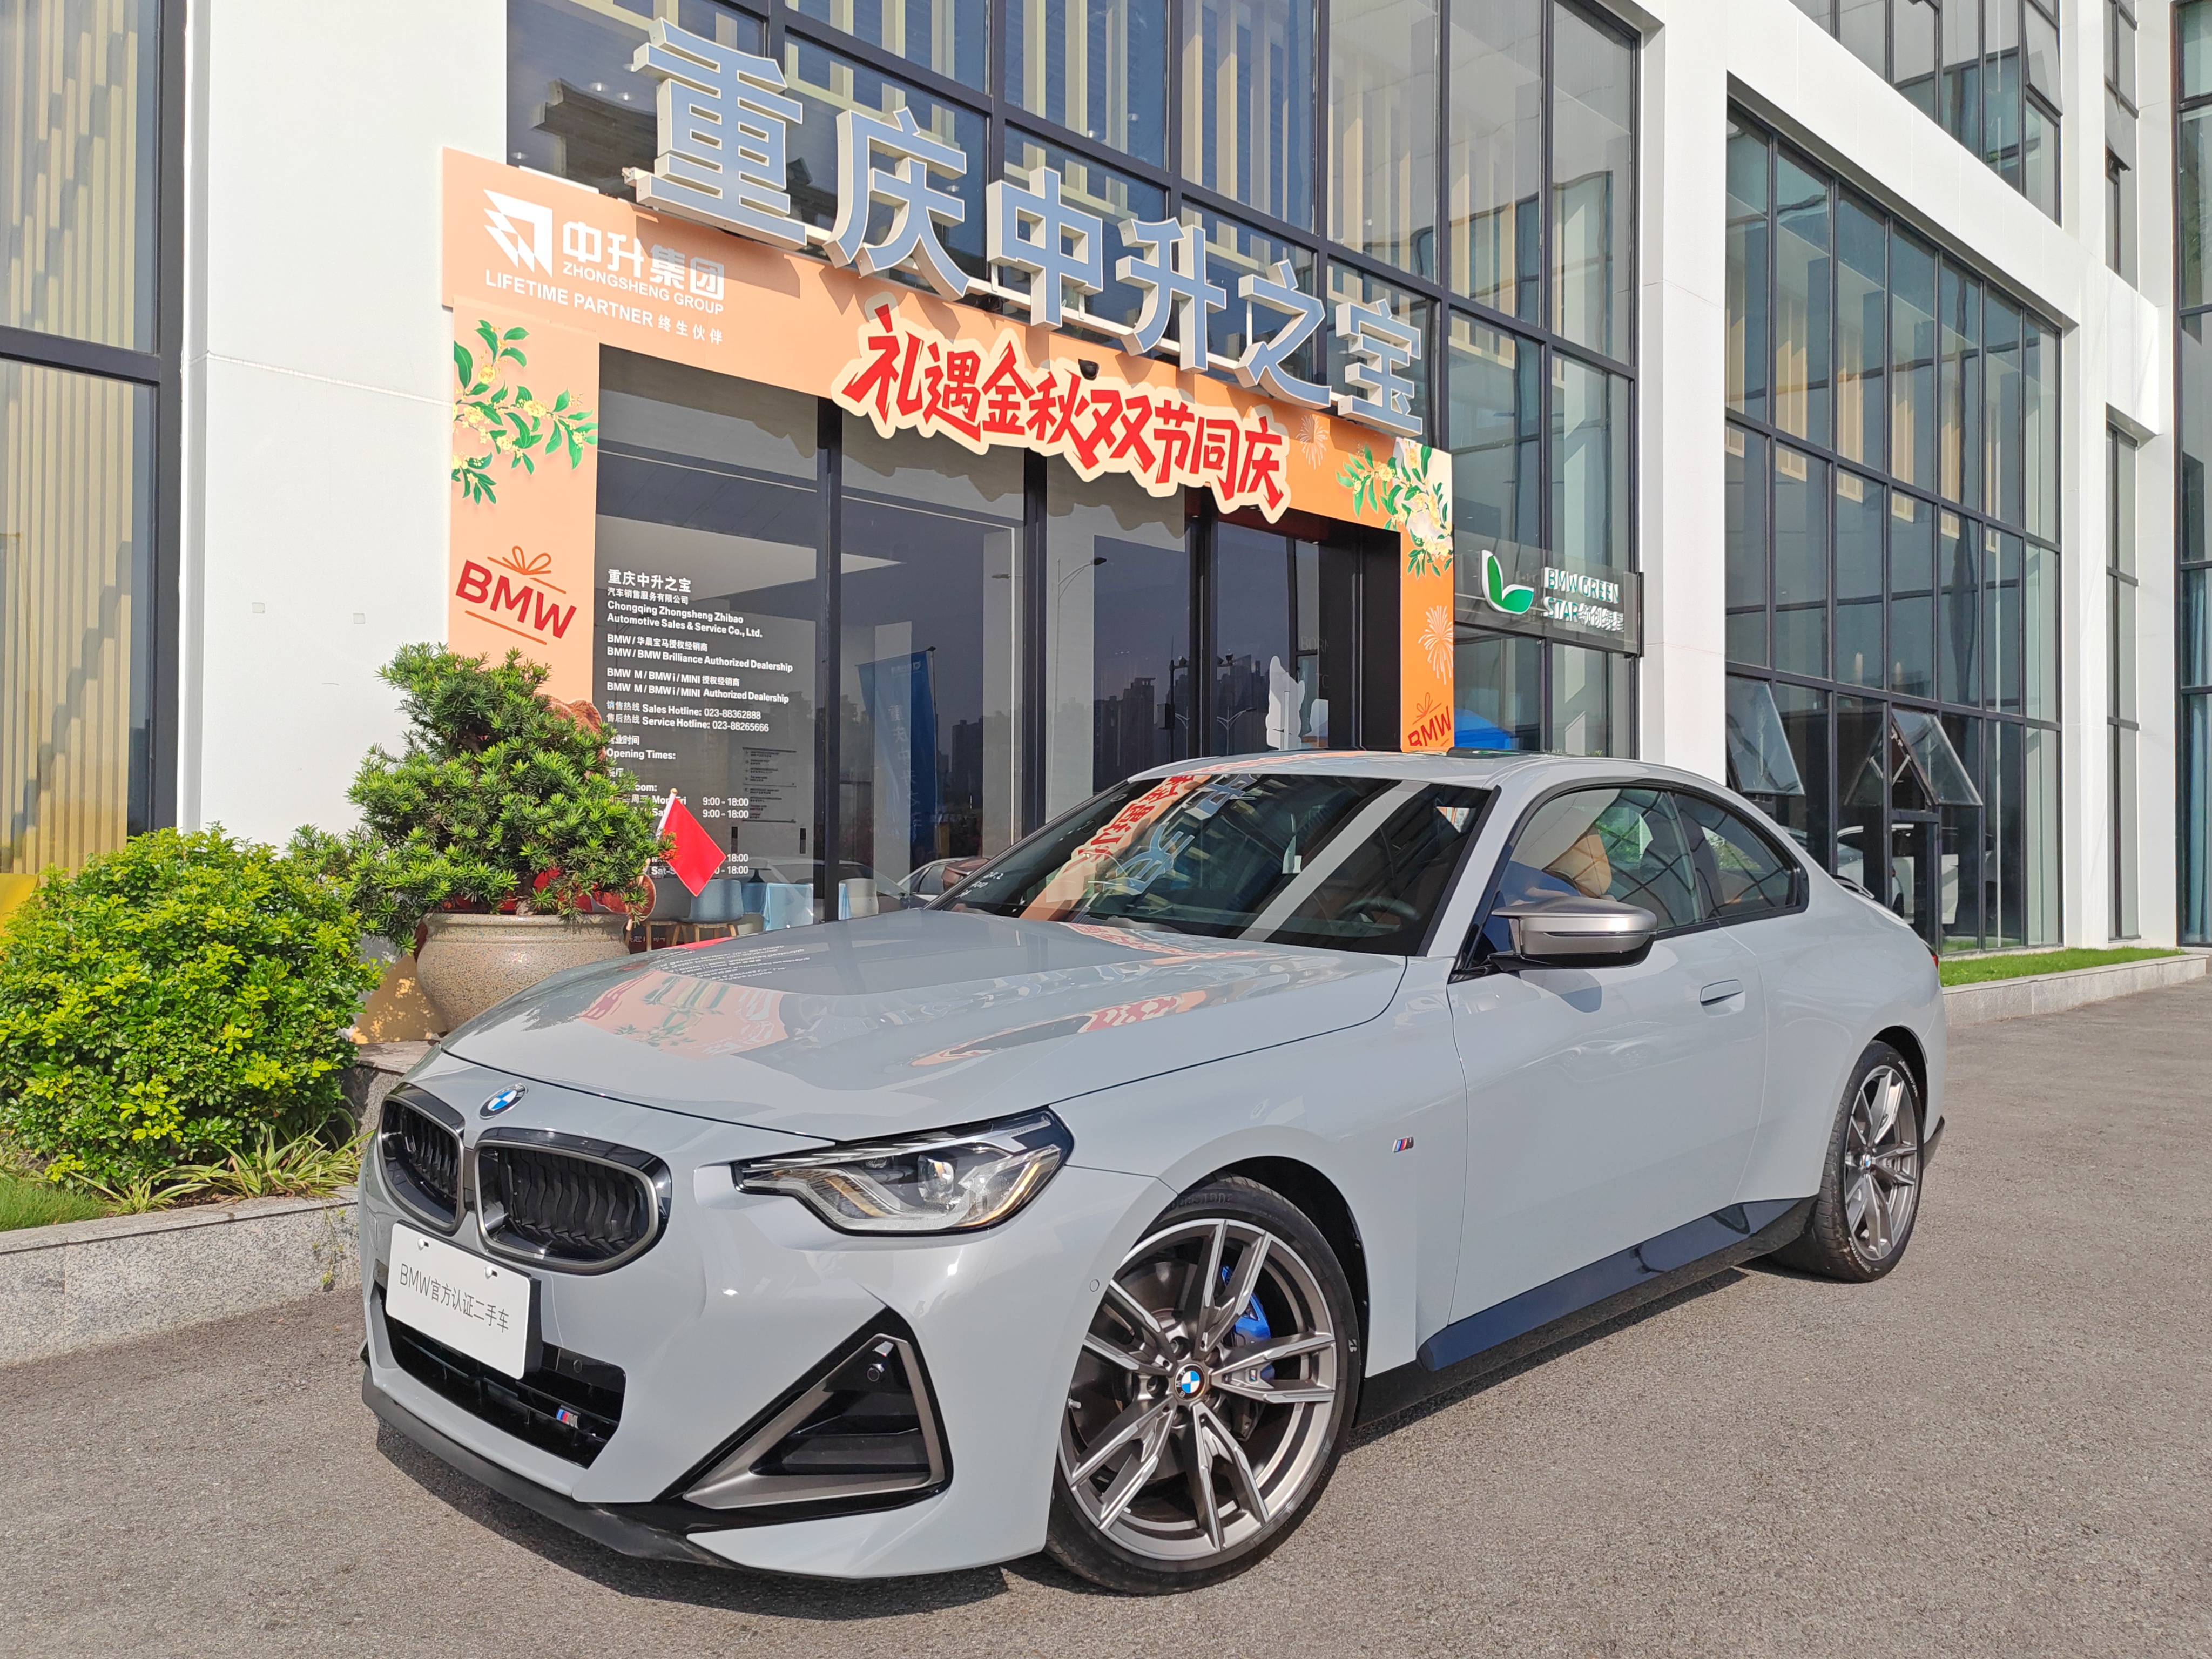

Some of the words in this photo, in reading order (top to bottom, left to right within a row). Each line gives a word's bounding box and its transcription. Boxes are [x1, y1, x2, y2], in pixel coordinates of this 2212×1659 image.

[634, 21, 1422, 435] 重庆中升之宝
[563, 221, 724, 300] 中升集团
[563, 261, 670, 302] ZHONGSHENG
[674, 295, 724, 315] GROUP
[485, 269, 569, 305] LIFETIME
[574, 292, 653, 327] PARTNER
[658, 315, 723, 346] 终生伙伴
[842, 303, 1284, 511] 礼遇金秋双节同庆
[608, 569, 691, 593] 重庆中升之宝
[1543, 567, 1578, 593] BMW
[1578, 576, 1619, 604] GREEN
[455, 559, 577, 639] BMW
[608, 586, 688, 605] 汽车销售服务有限公司
[608, 601, 657, 616] Chongqing
[659, 606, 713, 621] Zhongsheng
[714, 612, 744, 623] Zhibao
[1543, 596, 1579, 623] STAR
[607, 613, 659, 626] Automotive
[661, 619, 685, 629] Sales
[687, 622, 693, 630] &
[694, 622, 727, 634] Service
[746, 628, 763, 638] Ltd.
[607, 634, 631, 644] BMW
[637, 636, 707, 652] 华晨宝马授权经销商
[607, 646, 631, 657] BMW
[637, 649, 661, 660] BMW
[663, 652, 703, 663] Brilliance
[704, 656, 749, 667] Authorized
[751, 660, 793, 673] Dealership
[607, 667, 631, 678] BMW
[634, 670, 643, 679] M
[649, 671, 671, 682] BMW
[681, 674, 700, 684] MINI
[702, 675, 740, 687] 授权经销商
[607, 682, 631, 692] BMW
[634, 684, 643, 693] M
[649, 685, 671, 695] BMW
[681, 688, 700, 697] MINI
[703, 688, 747, 699] Authorized
[748, 691, 789, 704] Dealership
[606, 700, 640, 711] 销售热线
[643, 704, 666, 713] Sales
[668, 706, 702, 716] Hotline:
[704, 708, 761, 720] 023-88362888
[606, 713, 640, 724] 售后热线
[643, 716, 675, 726] Service
[677, 718, 710, 729] Hotline:
[712, 721, 769, 732] 023-88265666
[1408, 706, 1452, 746] BMW
[606, 748, 645, 760] Opening
[646, 750, 676, 759] Times:
[703, 797, 720, 806] 9:00
[727, 798, 749, 807] 18:00
[703, 810, 720, 818] 9:00
[727, 810, 749, 819] 18:00
[727, 854, 748, 862] 18:00
[727, 866, 748, 874] 18:00
[400, 1263, 509, 1333] BMW官方认证二手车
